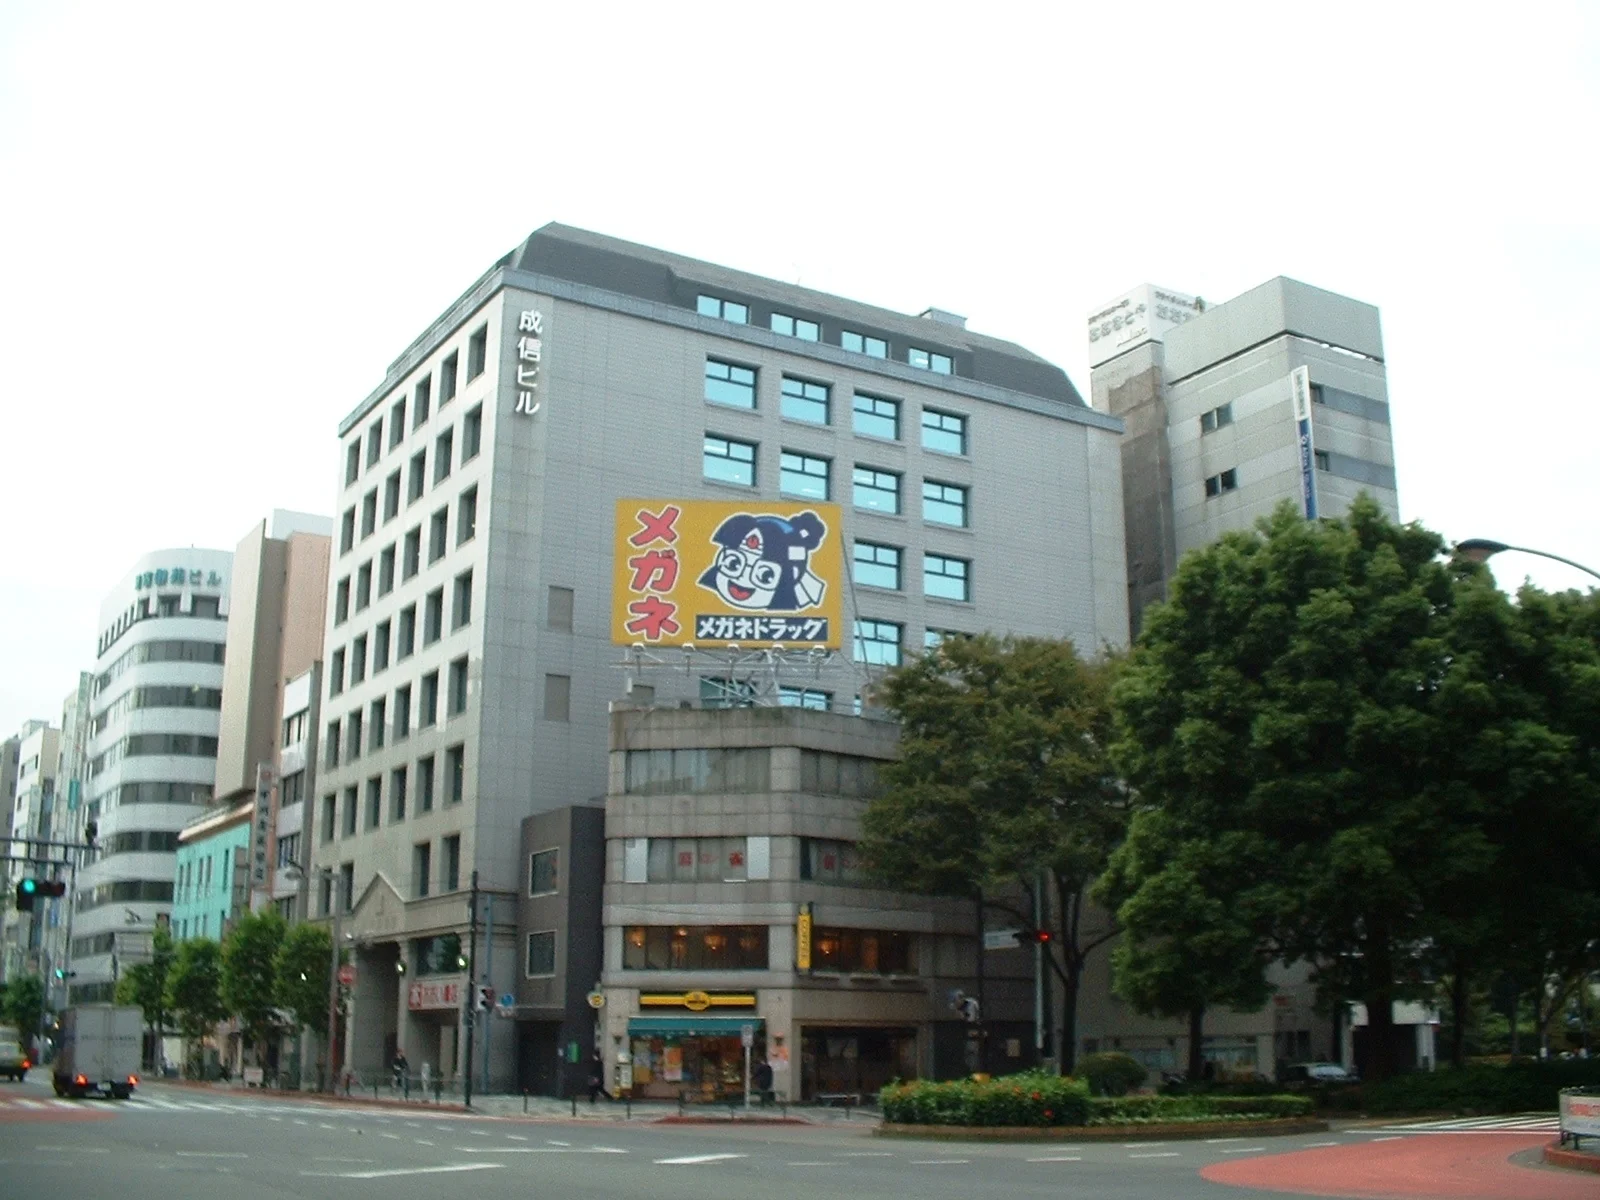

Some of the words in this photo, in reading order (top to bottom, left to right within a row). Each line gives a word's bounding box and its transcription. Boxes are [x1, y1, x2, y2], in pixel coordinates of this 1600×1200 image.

[515, 309, 543, 415] 成信ビル
[624, 503, 682, 642] メガネ
[697, 616, 827, 641] メガネドラッグ
